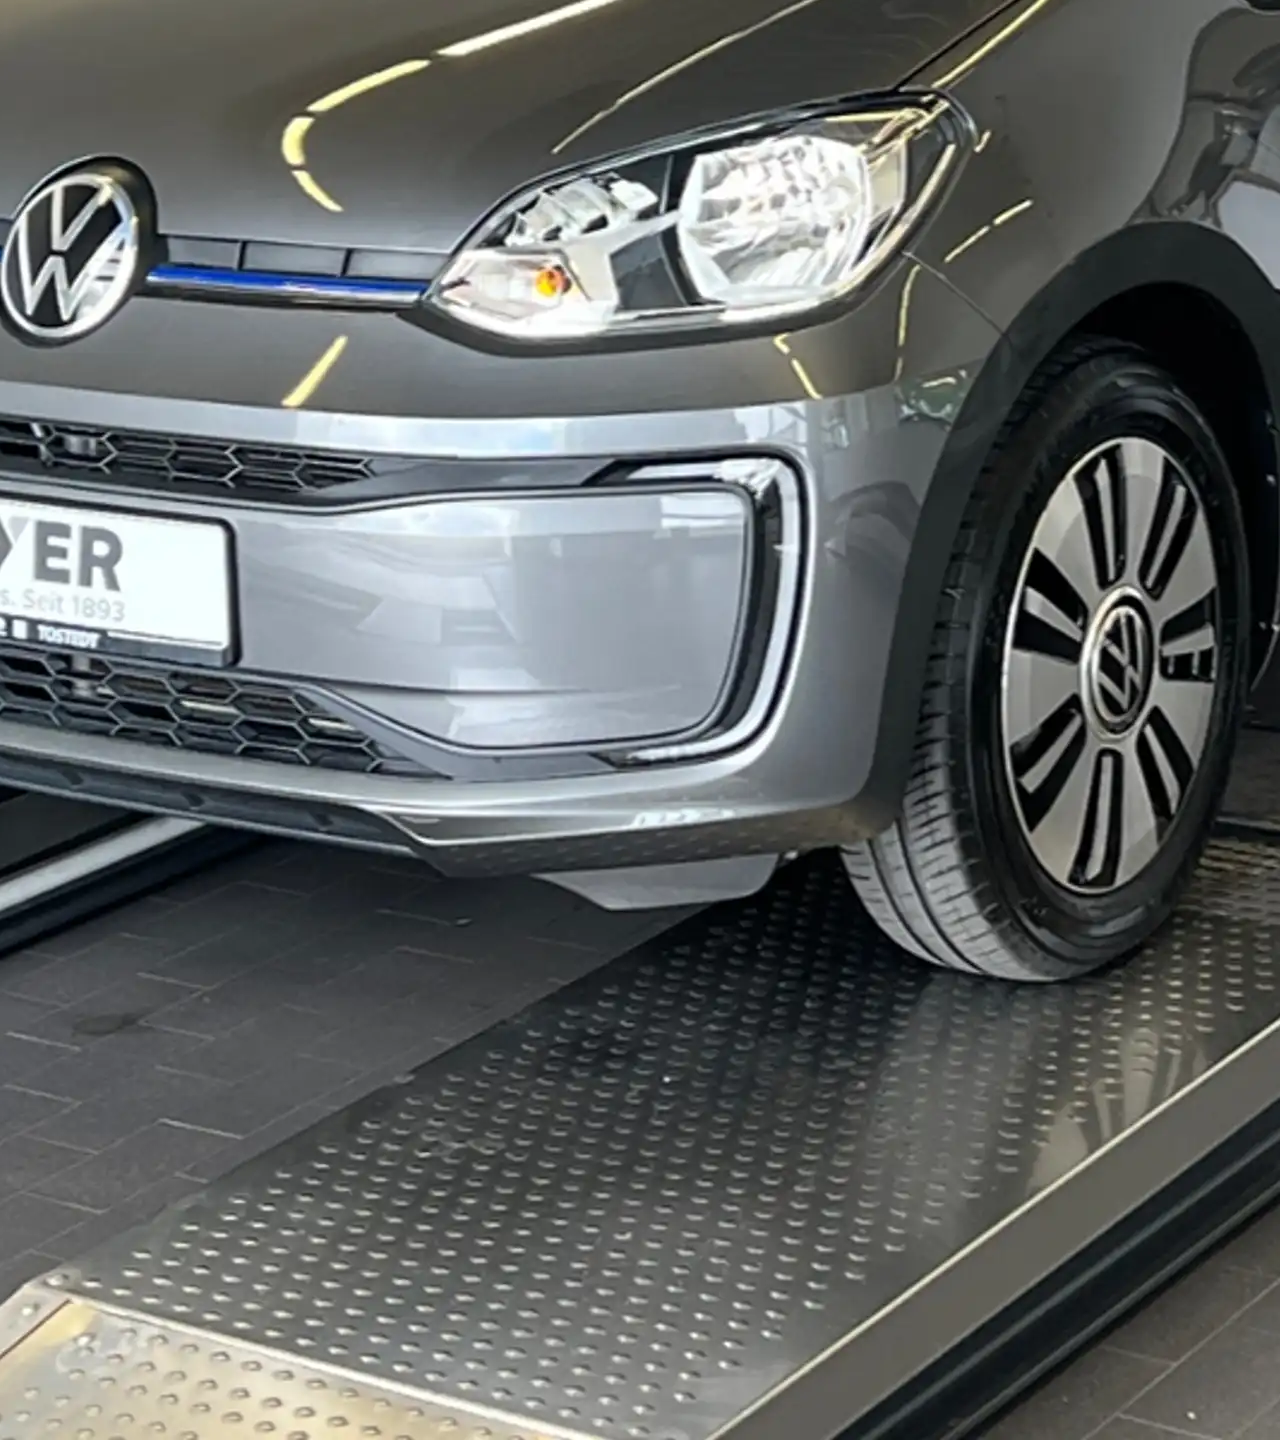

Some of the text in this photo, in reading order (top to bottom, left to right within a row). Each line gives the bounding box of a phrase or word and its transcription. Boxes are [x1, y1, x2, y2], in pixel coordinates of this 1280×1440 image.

[2, 175, 137, 336] VW
[23, 588, 64, 615] Seit
[71, 593, 126, 623] 1893
